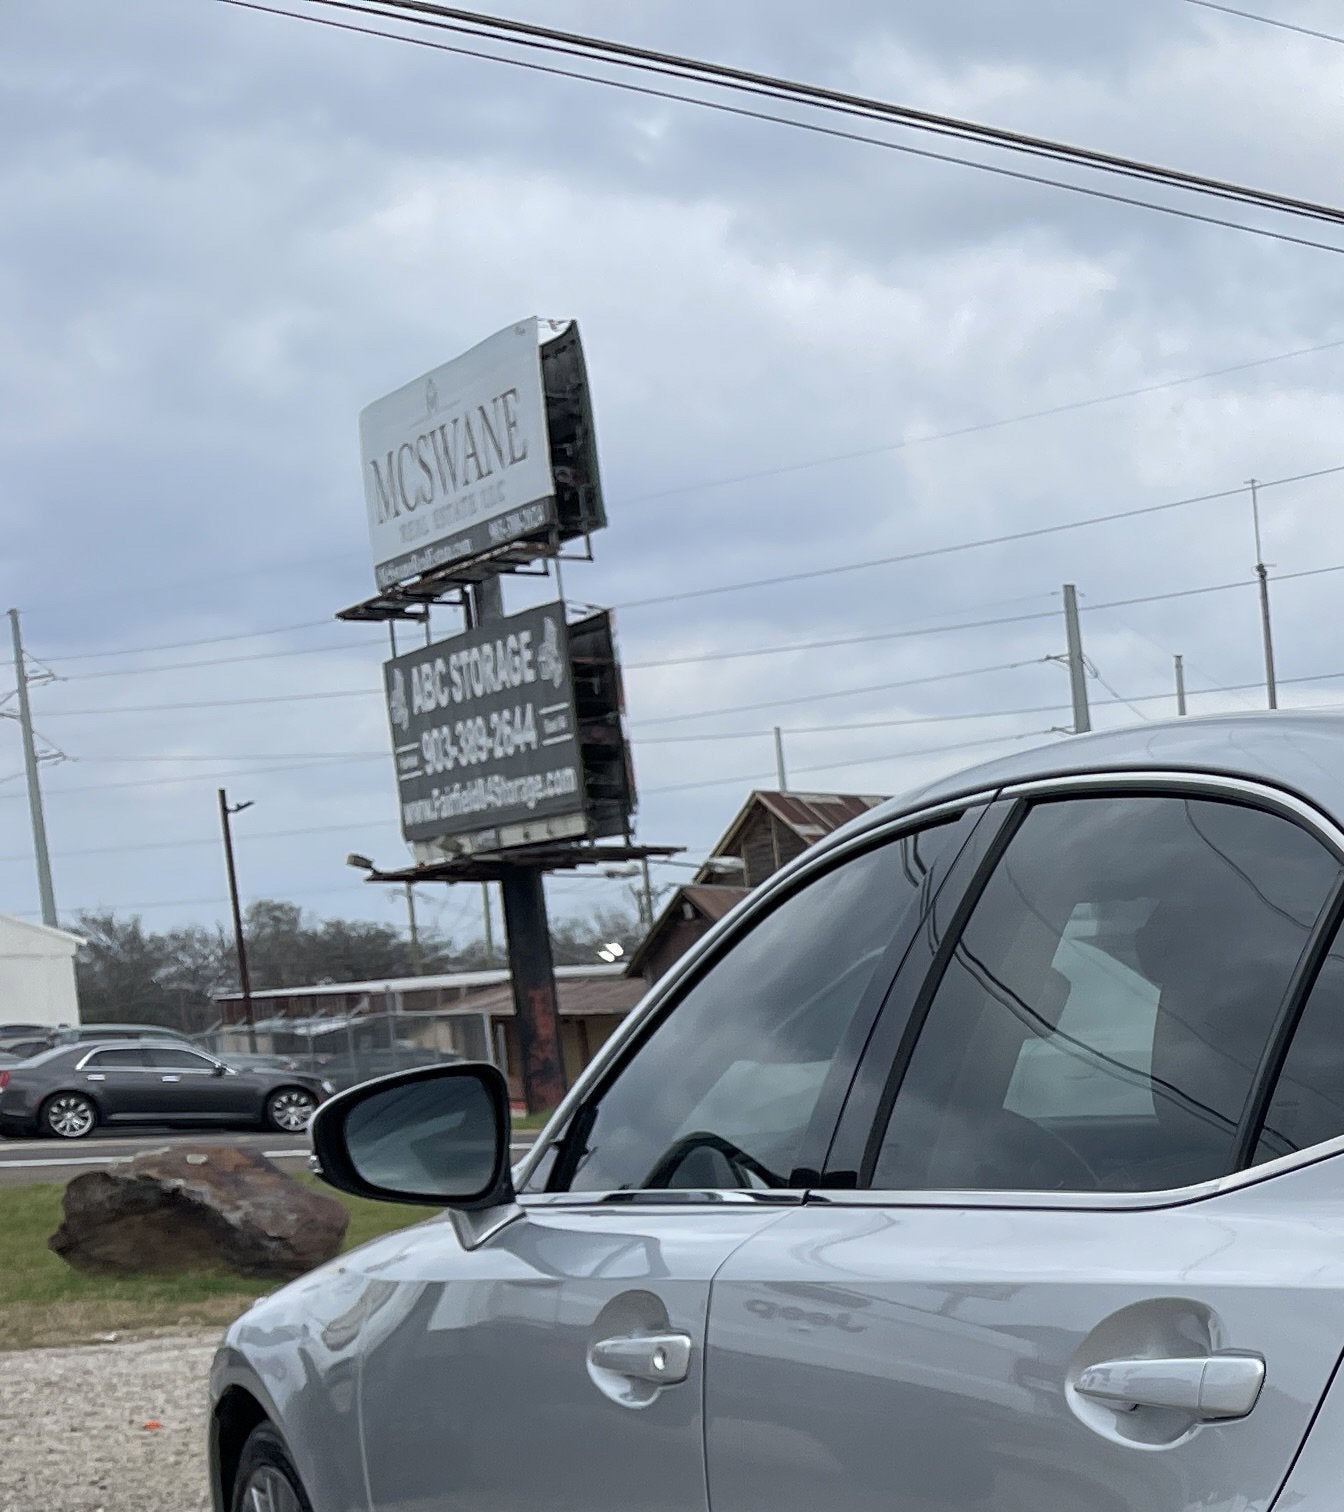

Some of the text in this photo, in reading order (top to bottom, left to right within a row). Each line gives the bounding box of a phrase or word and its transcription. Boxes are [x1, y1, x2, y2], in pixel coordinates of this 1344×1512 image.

[370, 388, 528, 525] MCSWANE
[411, 630, 537, 715] ABC STORAGE
